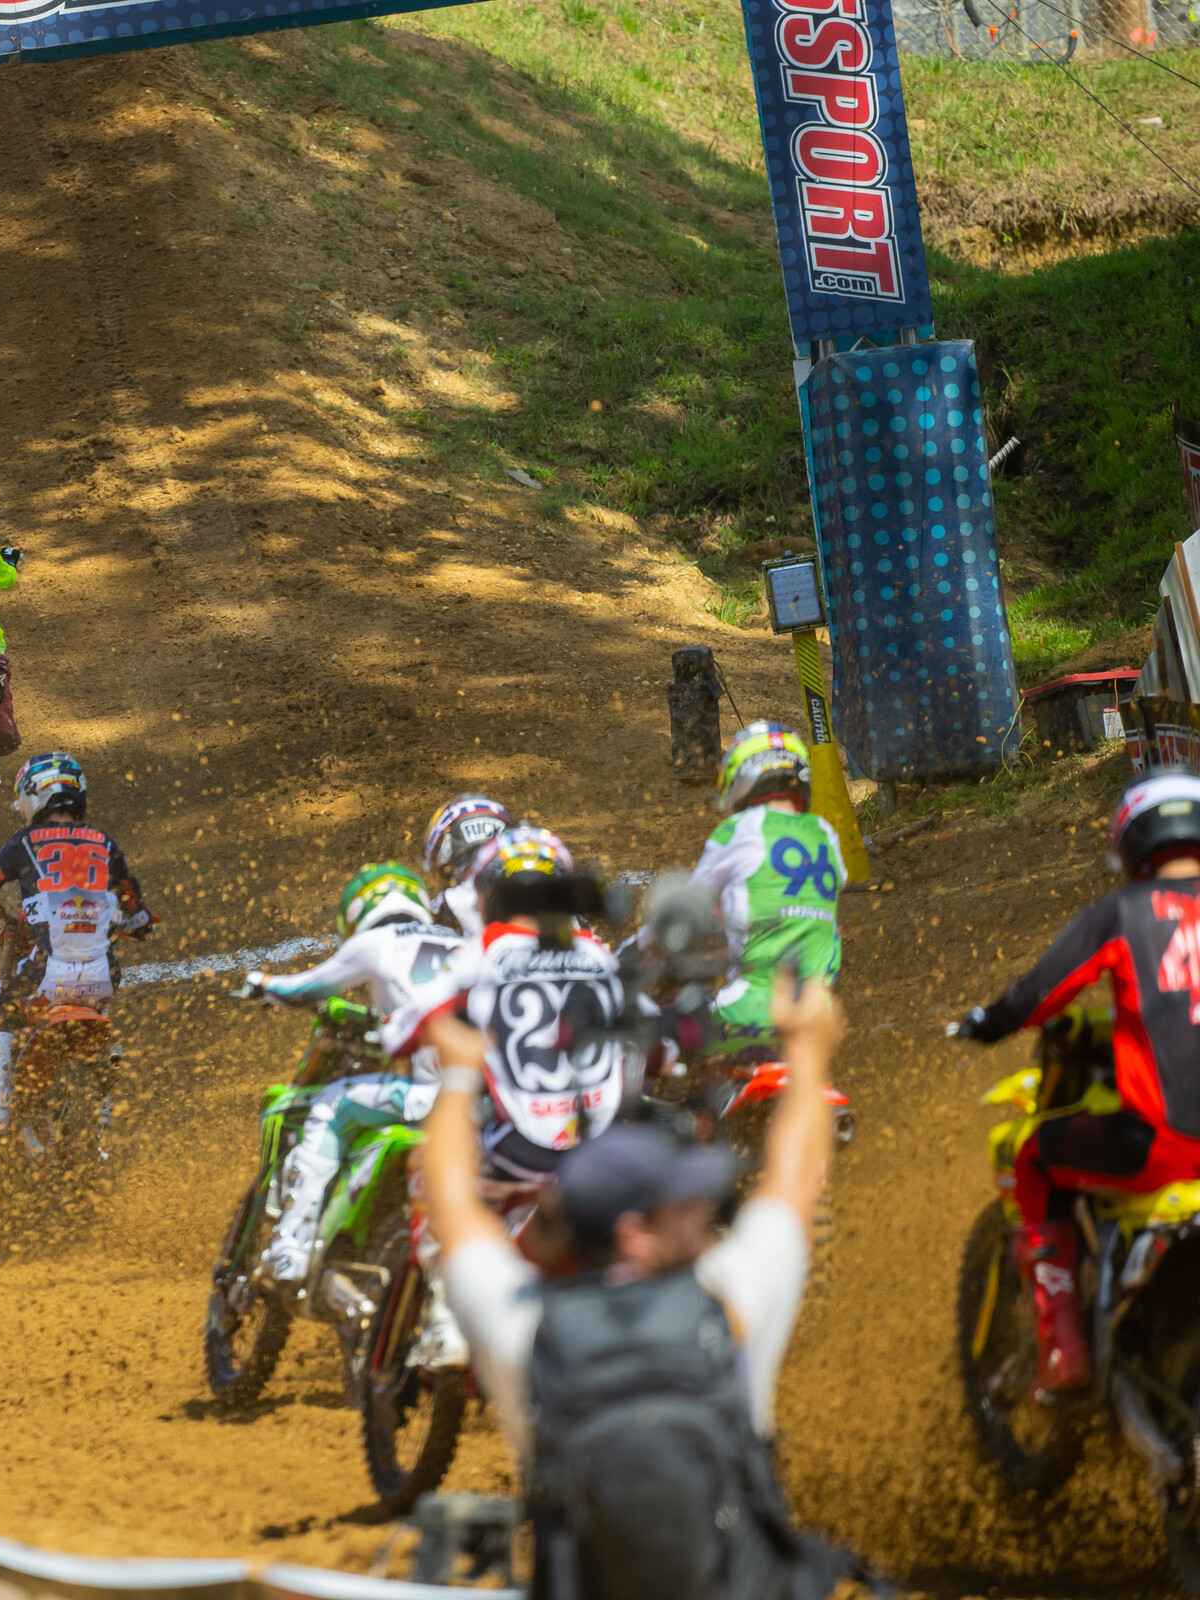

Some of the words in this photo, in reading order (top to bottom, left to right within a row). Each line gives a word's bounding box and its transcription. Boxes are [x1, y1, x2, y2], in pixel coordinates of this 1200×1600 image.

[778, 0, 900, 299] SPORT
[811, 698, 826, 745] CAUTIO
[36, 841, 111, 892] 36
[771, 836, 838, 902] 96
